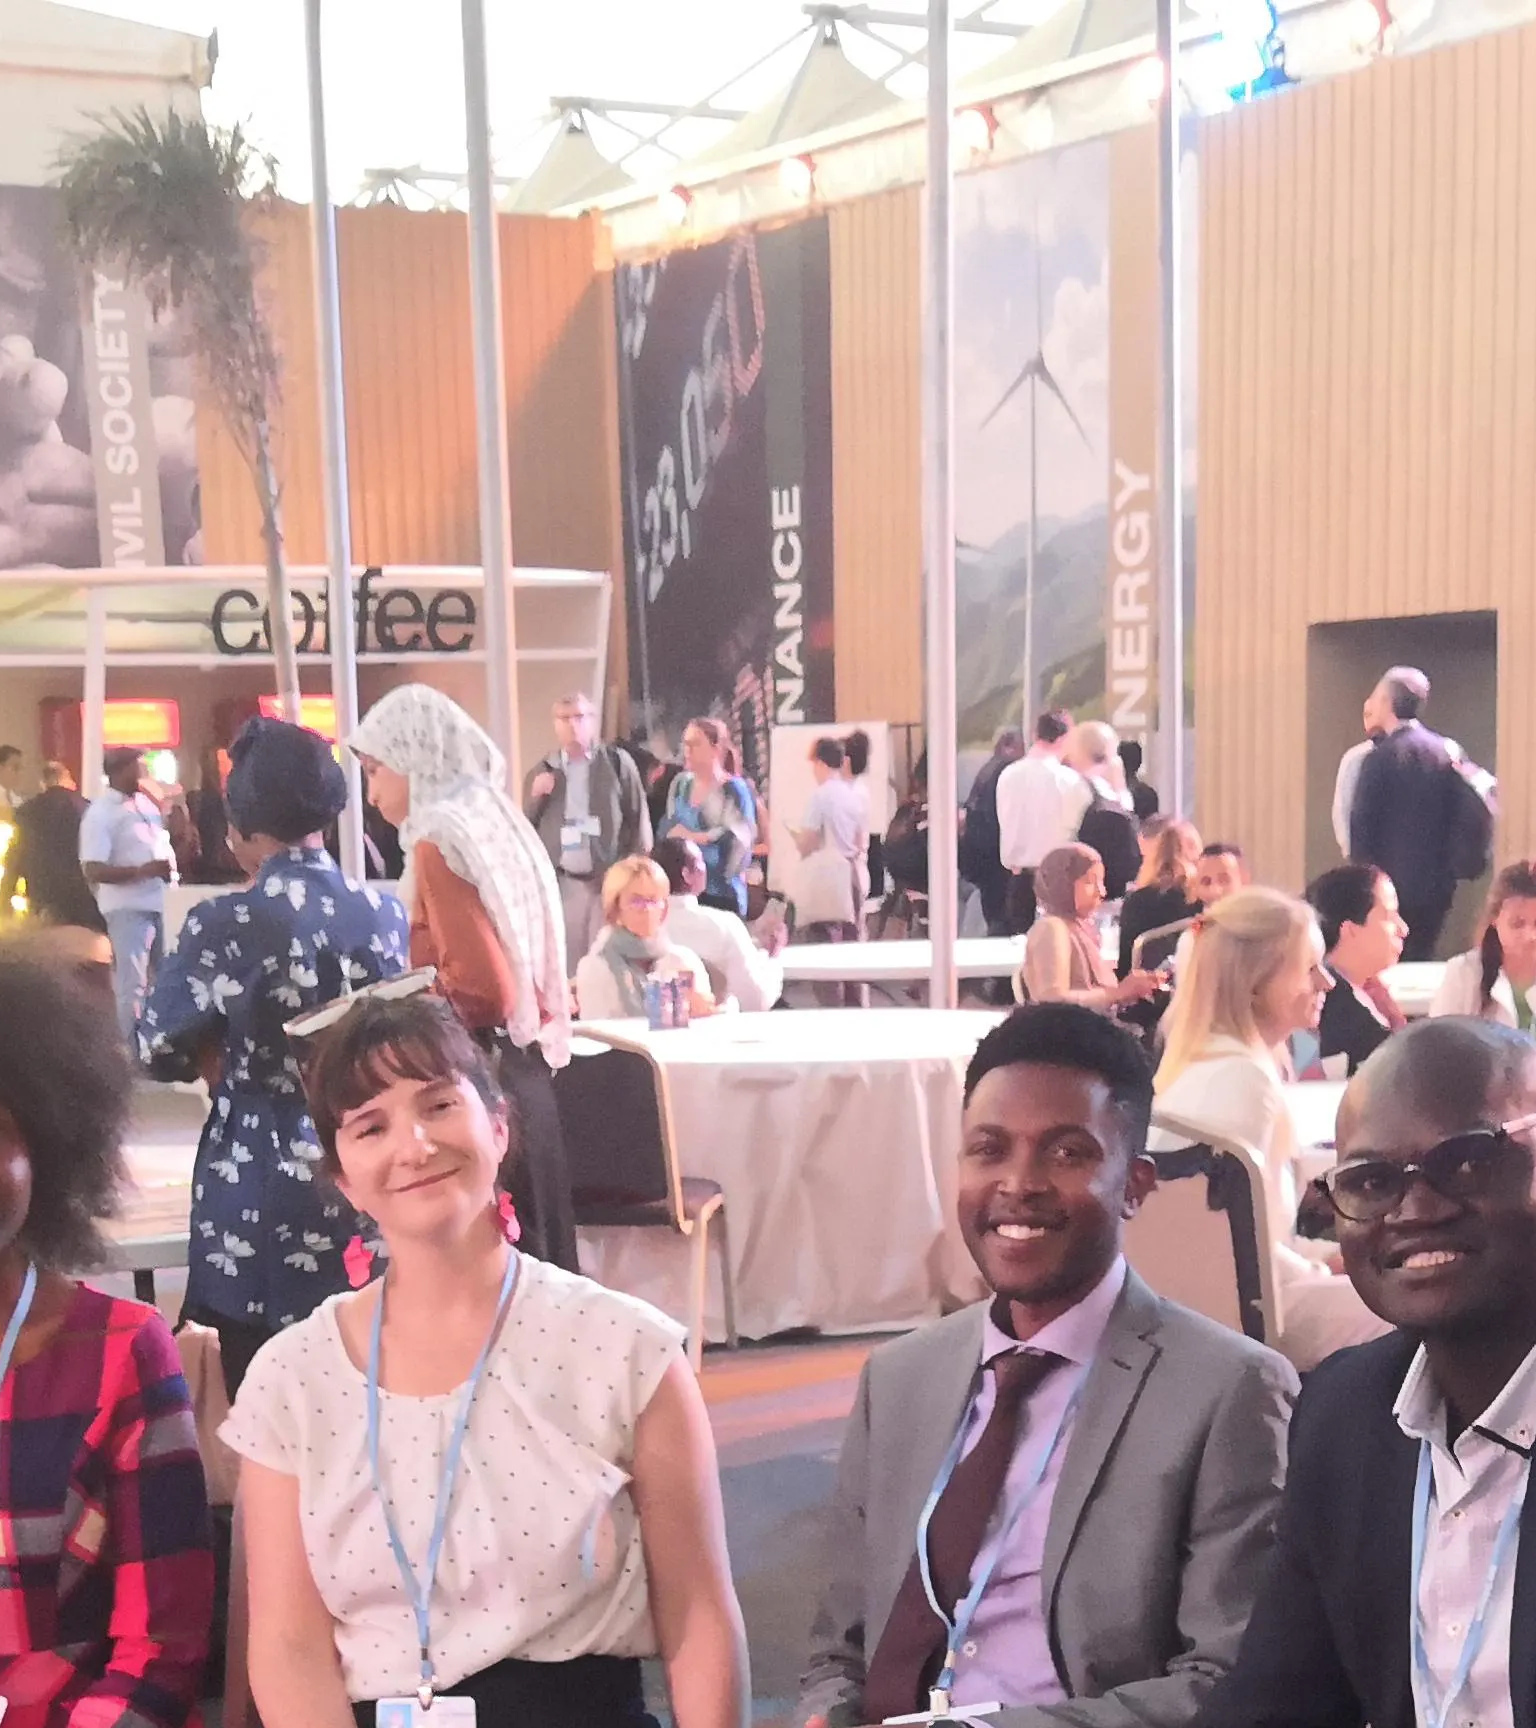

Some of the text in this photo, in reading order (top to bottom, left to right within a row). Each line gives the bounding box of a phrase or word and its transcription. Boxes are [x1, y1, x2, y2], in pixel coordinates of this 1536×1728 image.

[93, 270, 140, 475] SOCIETY
[212, 568, 477, 655] cofee
[771, 484, 806, 724] NANCE
